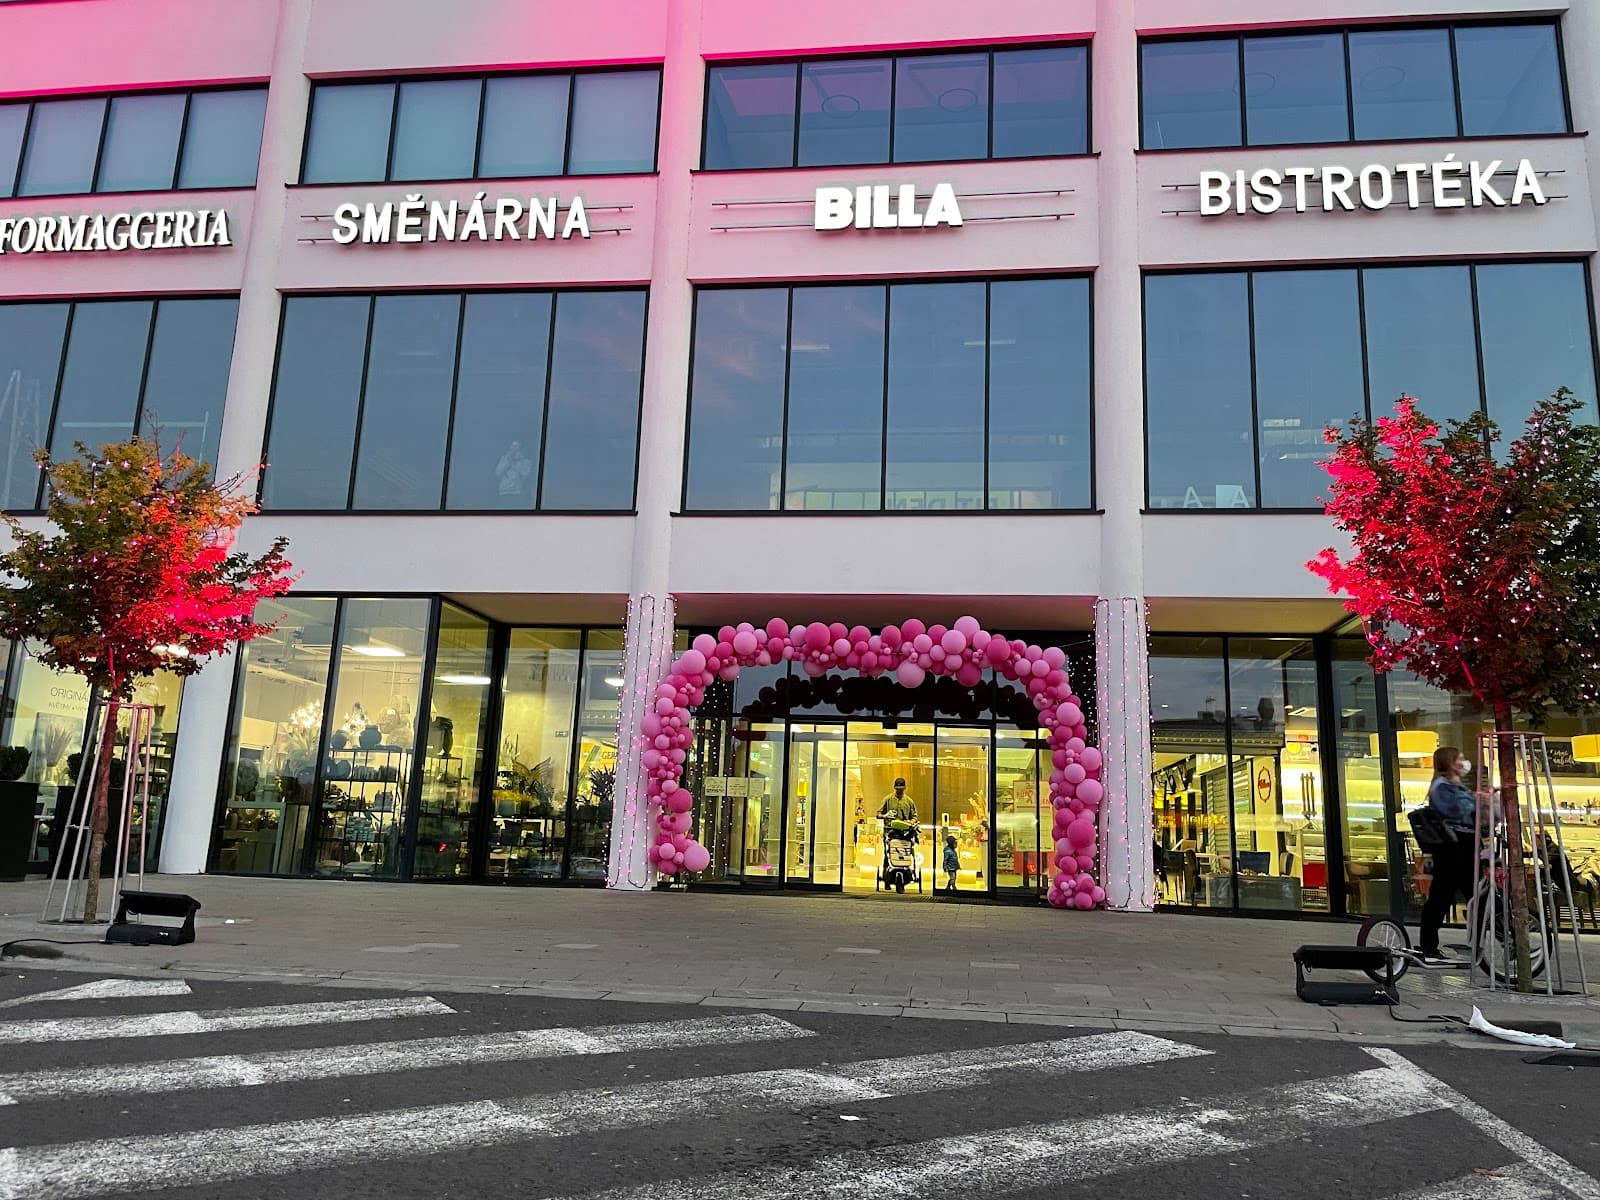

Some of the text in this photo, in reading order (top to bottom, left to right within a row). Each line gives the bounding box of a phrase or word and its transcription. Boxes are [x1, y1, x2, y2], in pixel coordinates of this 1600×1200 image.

[814, 183, 963, 229] BILLA
[1199, 153, 1546, 215] BISTROTÉKA
[0, 208, 231, 253] FORMAGGERIA
[332, 192, 590, 243] SMĚNÁRNA
